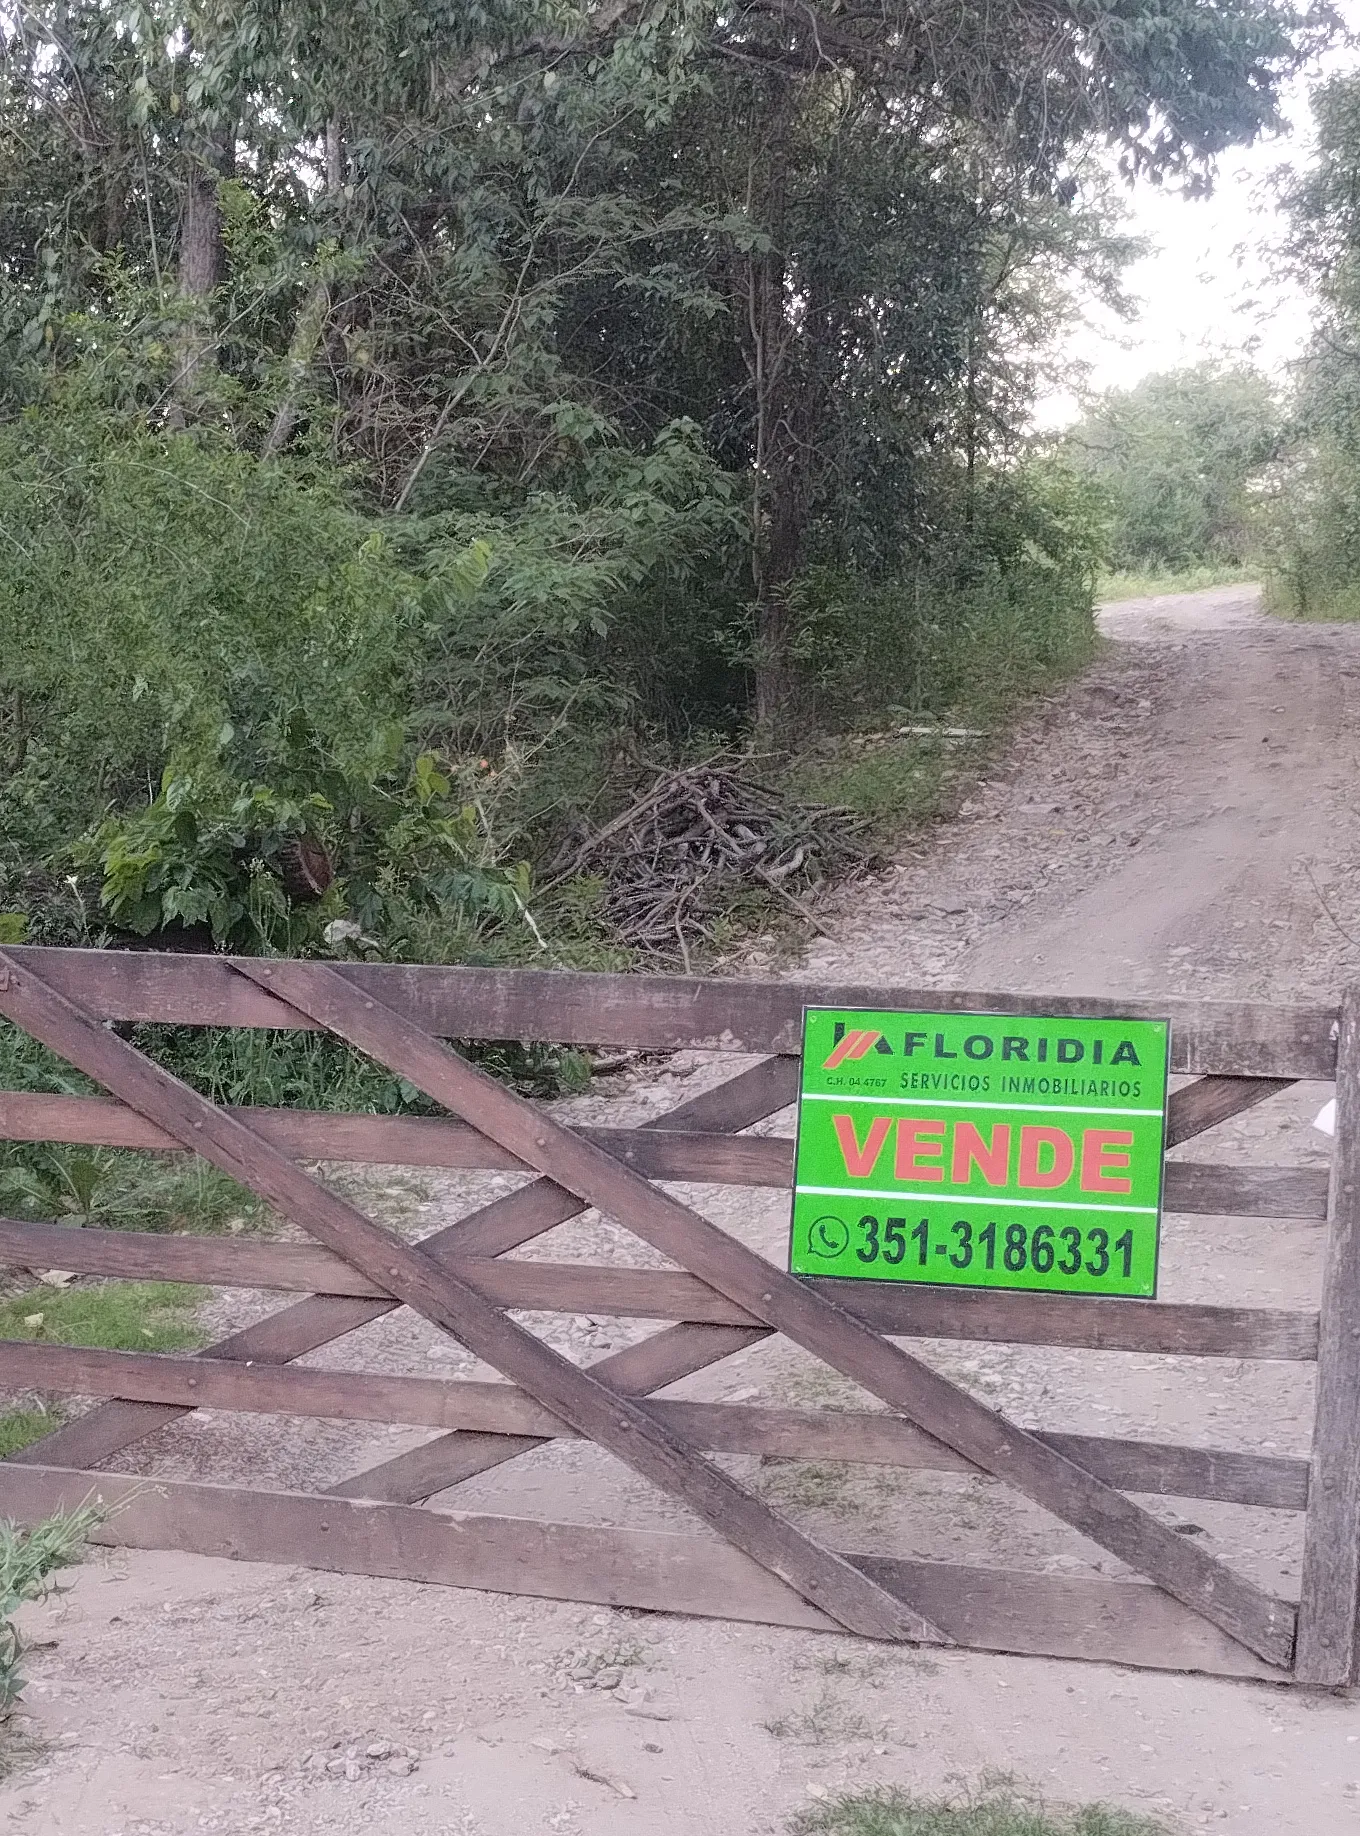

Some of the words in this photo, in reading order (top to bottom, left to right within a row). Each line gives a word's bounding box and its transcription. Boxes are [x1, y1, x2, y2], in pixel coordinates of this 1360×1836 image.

[904, 1032, 1142, 1066] FLORIDIA
[900, 1072, 991, 1091] SERVICIOS
[1001, 1075, 1141, 1098] INMOBILIARIOS
[832, 1115, 1134, 1194] VENDE
[856, 1215, 1134, 1278] 351-3186331
